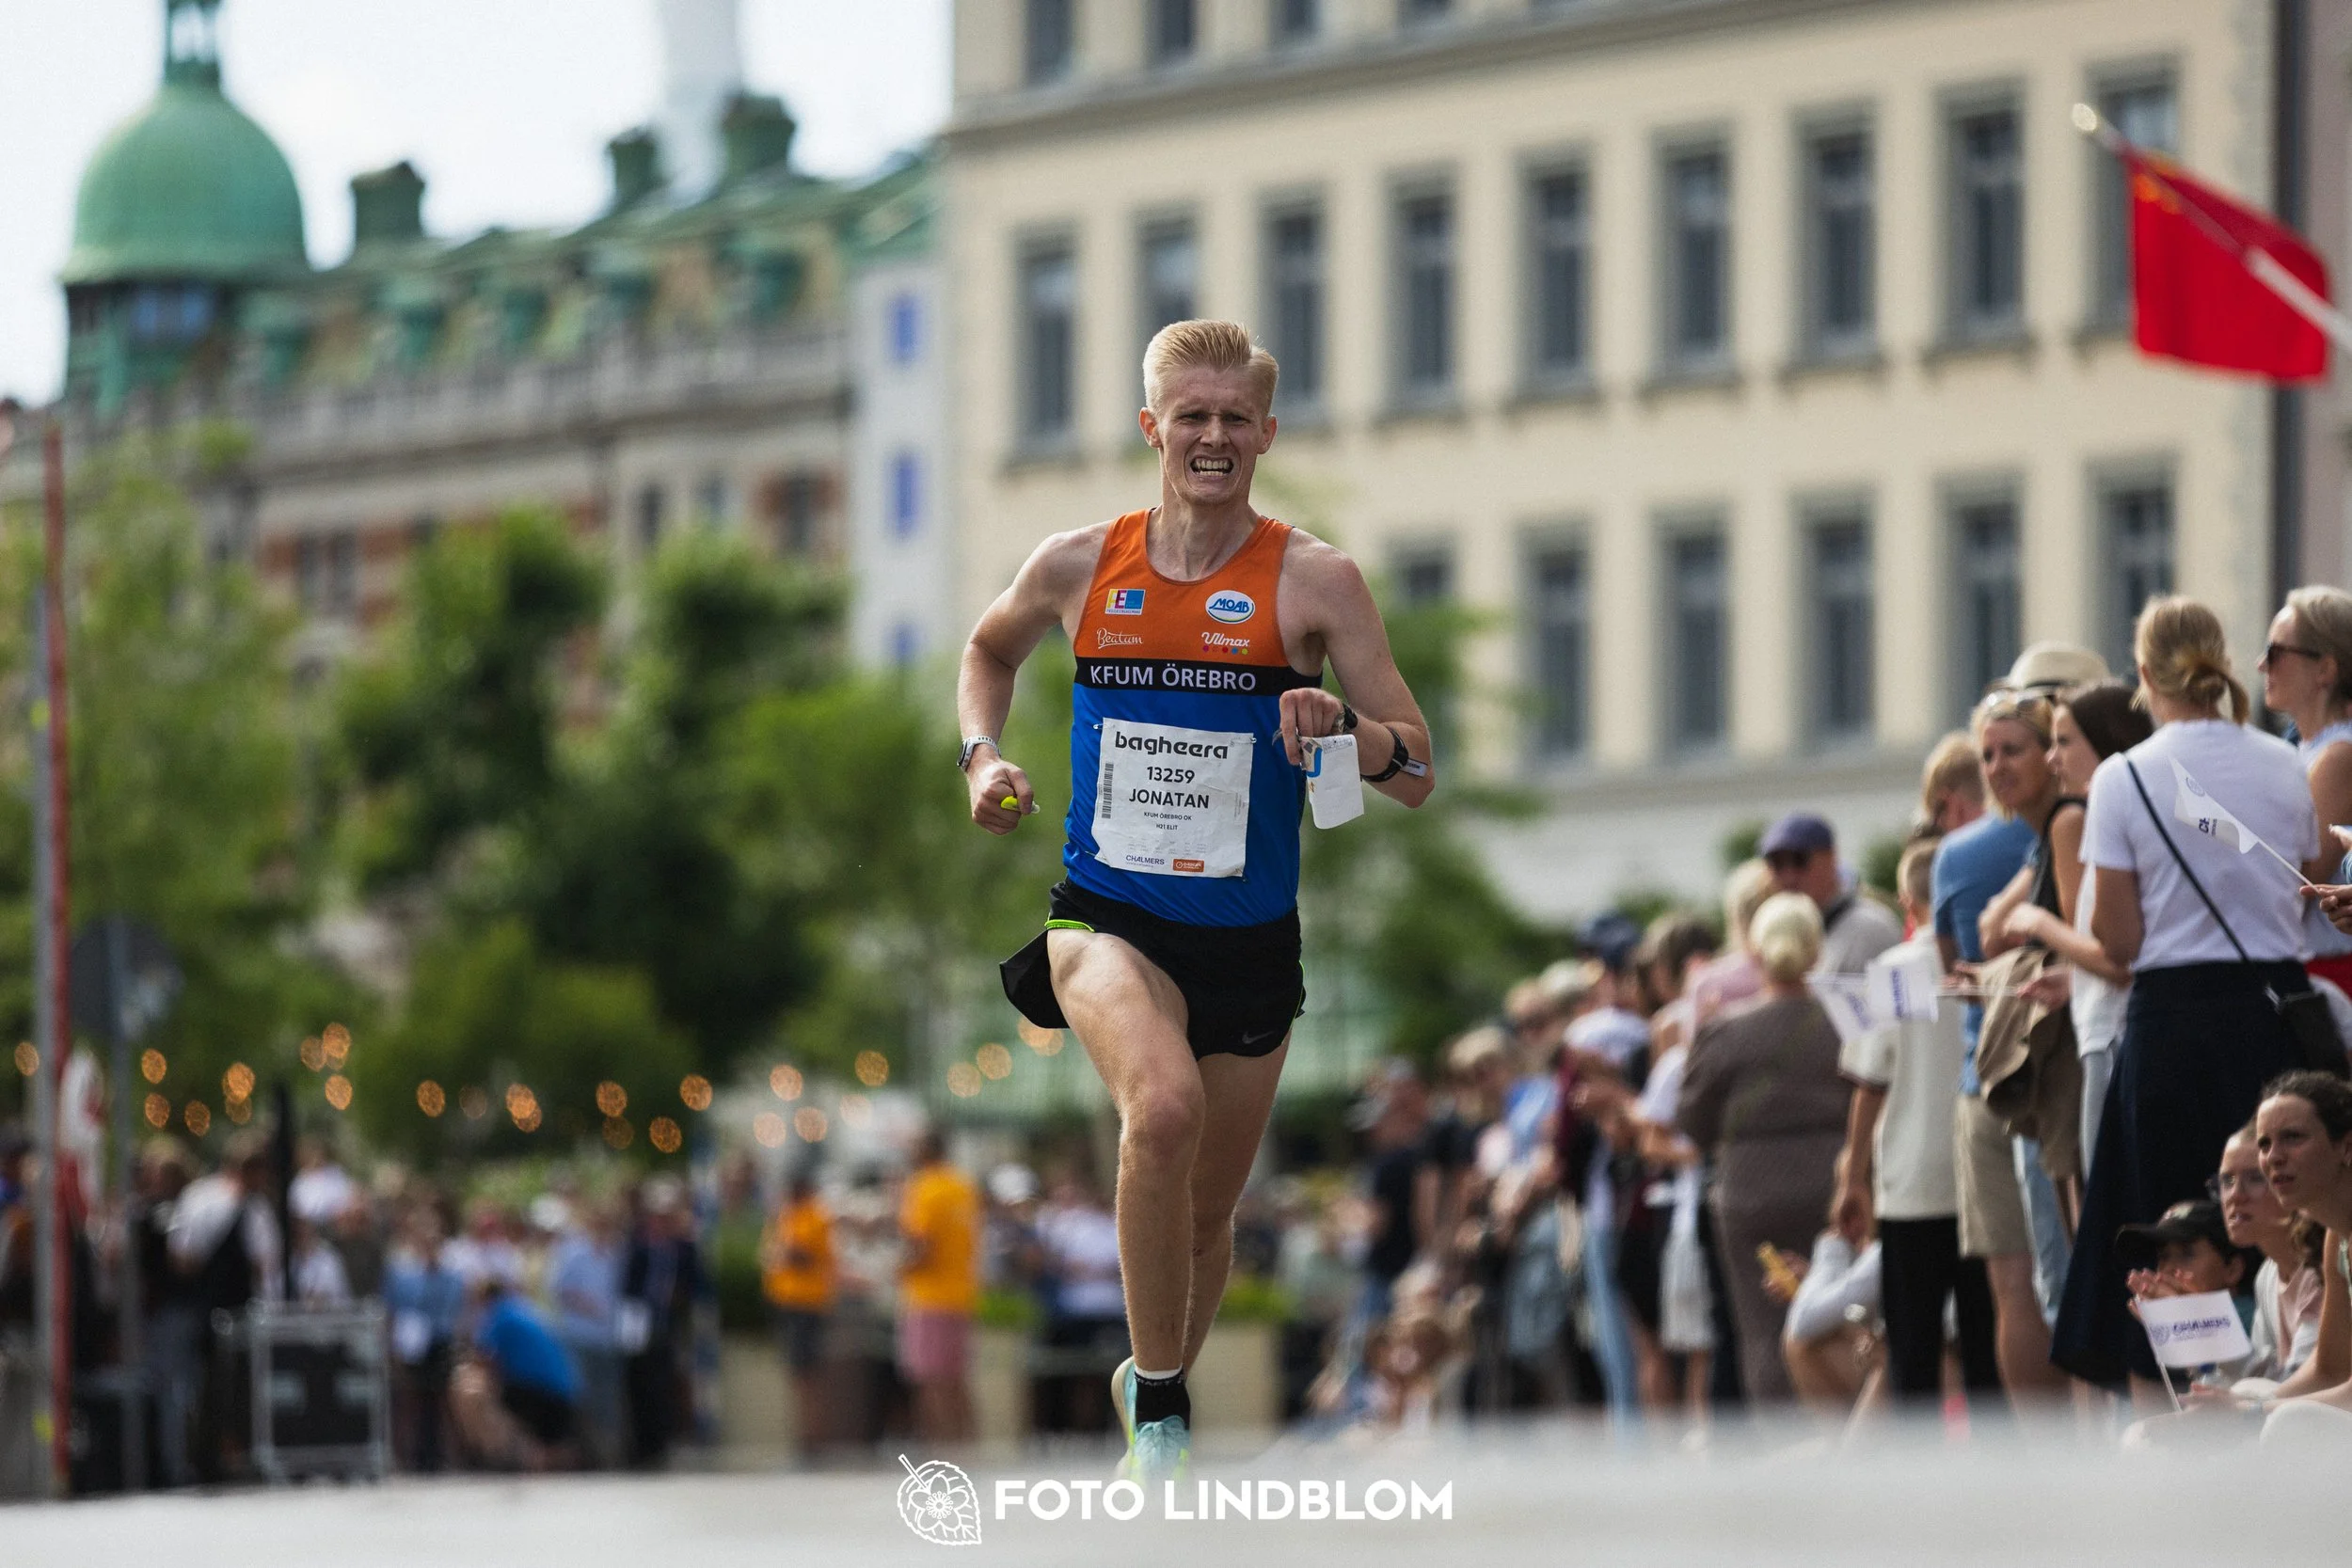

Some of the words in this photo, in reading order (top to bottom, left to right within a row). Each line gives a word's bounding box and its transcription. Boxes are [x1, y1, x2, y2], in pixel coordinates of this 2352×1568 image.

[1209, 597, 1249, 613] MOAB
[1097, 627, 1144, 649] Beatum
[1201, 631, 1250, 647] Ullmax
[1090, 665, 1153, 686] KFUM
[1162, 663, 1256, 691] ÖREBRO
[1115, 731, 1229, 759] bagheera
[1147, 767, 1195, 784] 13259
[1129, 788, 1210, 809] JONATAN
[1159, 812, 1183, 820] ÖREBRO
[1126, 855, 1165, 865] CHALMERS
